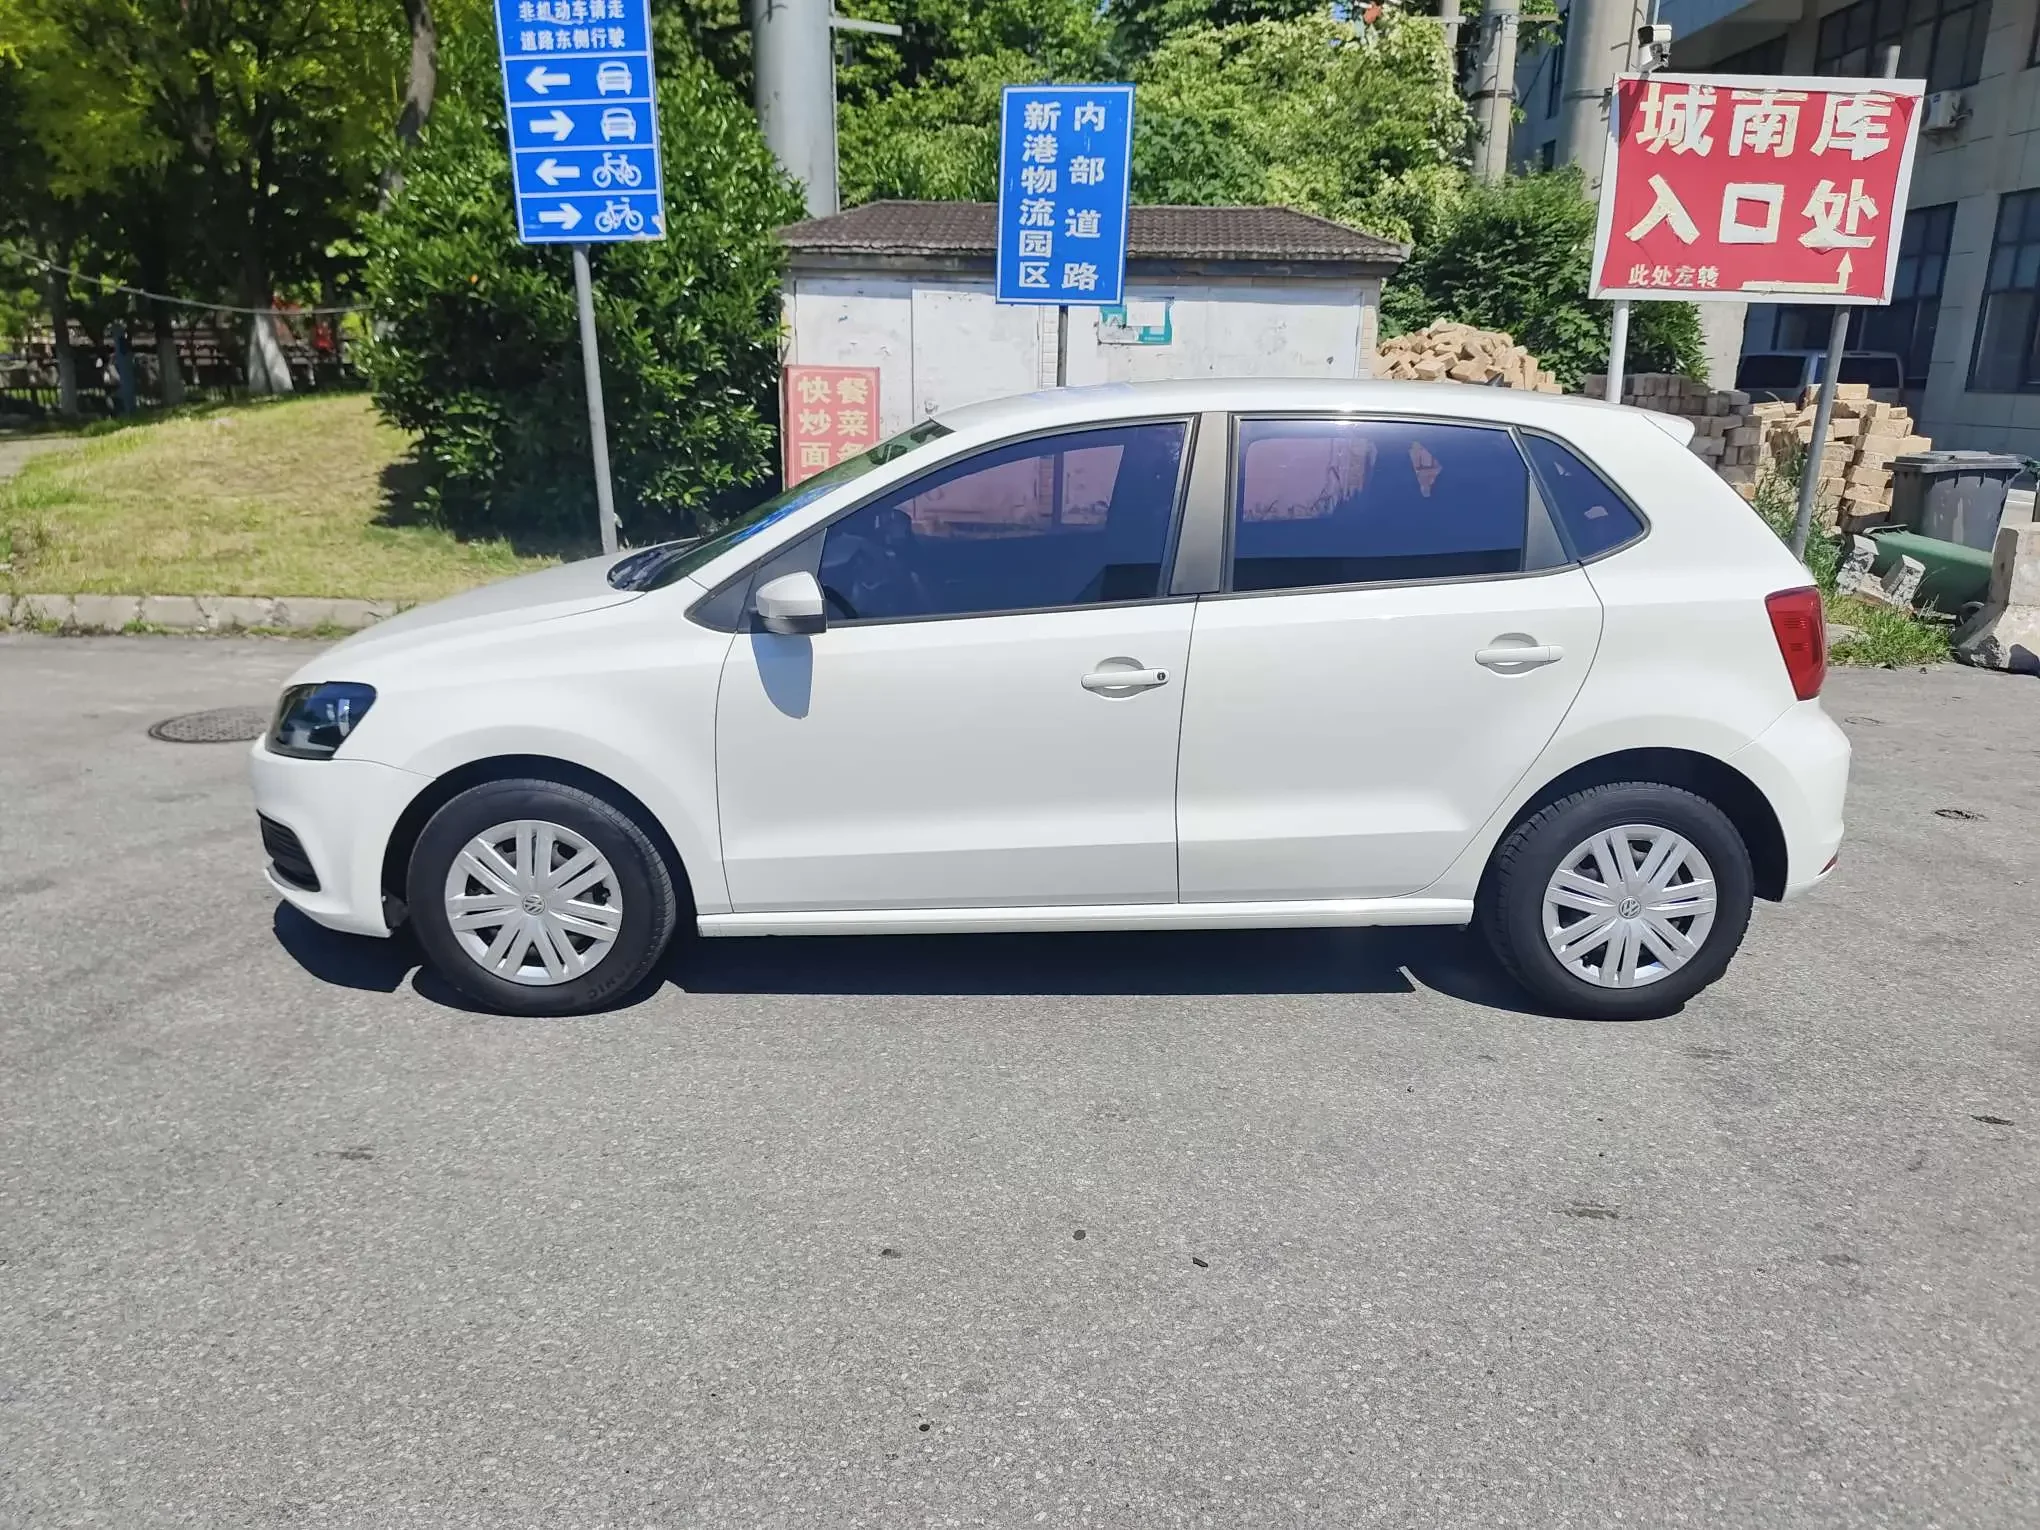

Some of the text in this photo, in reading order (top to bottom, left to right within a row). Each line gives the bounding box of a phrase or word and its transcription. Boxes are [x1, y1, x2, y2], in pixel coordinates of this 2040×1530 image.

[520, 26, 626, 51] 道路东侧行驶
[1636, 82, 1896, 161] 城南库
[1018, 101, 1061, 289] 新港物流园区
[1061, 101, 1106, 291] 内部道路
[1625, 174, 1879, 250] 入口处
[1628, 264, 1720, 288] 此处左转
[798, 376, 869, 405] 快餐
[799, 408, 869, 437] 炒菜
